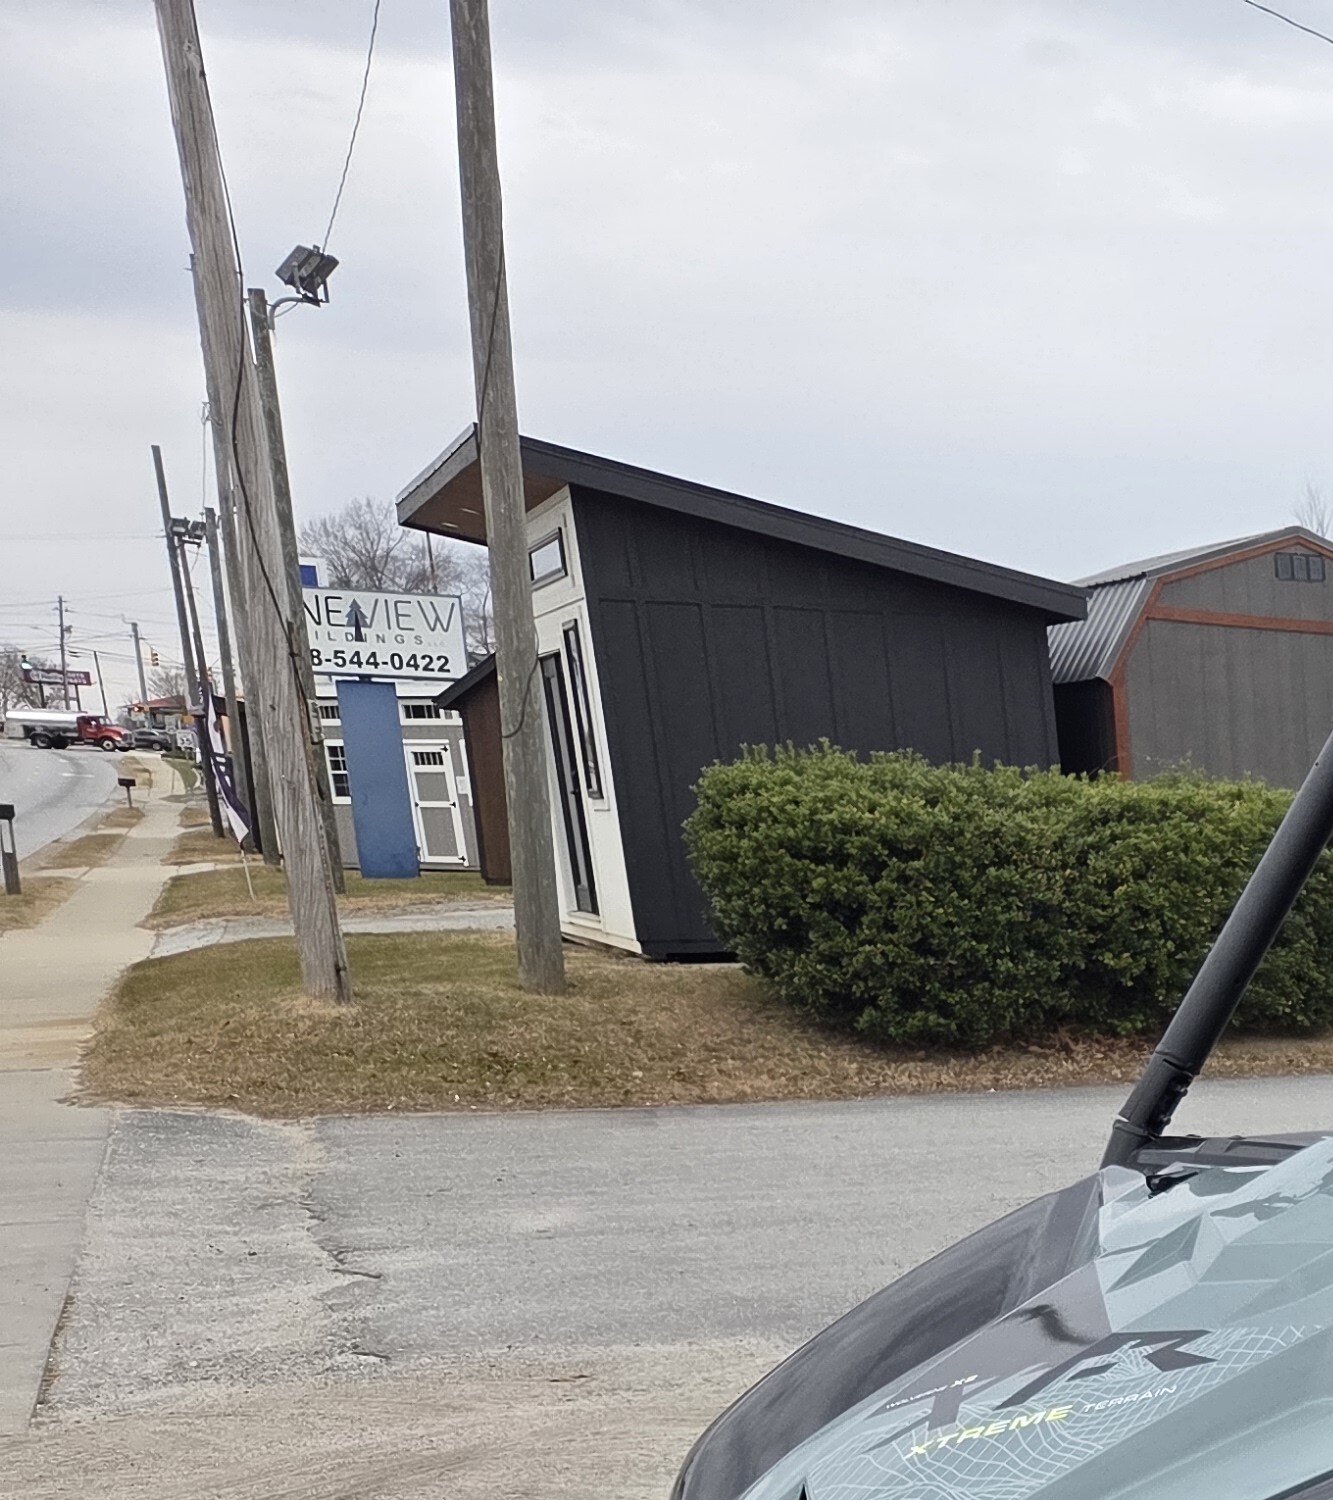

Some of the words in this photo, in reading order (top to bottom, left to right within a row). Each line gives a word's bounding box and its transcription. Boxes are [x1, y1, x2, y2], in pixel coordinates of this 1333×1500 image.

[304, 594, 455, 633] NEVIEW
[315, 630, 424, 645] ILDINGS
[311, 649, 451, 673] 8-544-0422
[905, 1404, 1074, 1458] XTREME
[1083, 1385, 1178, 1413] TERRAIN
